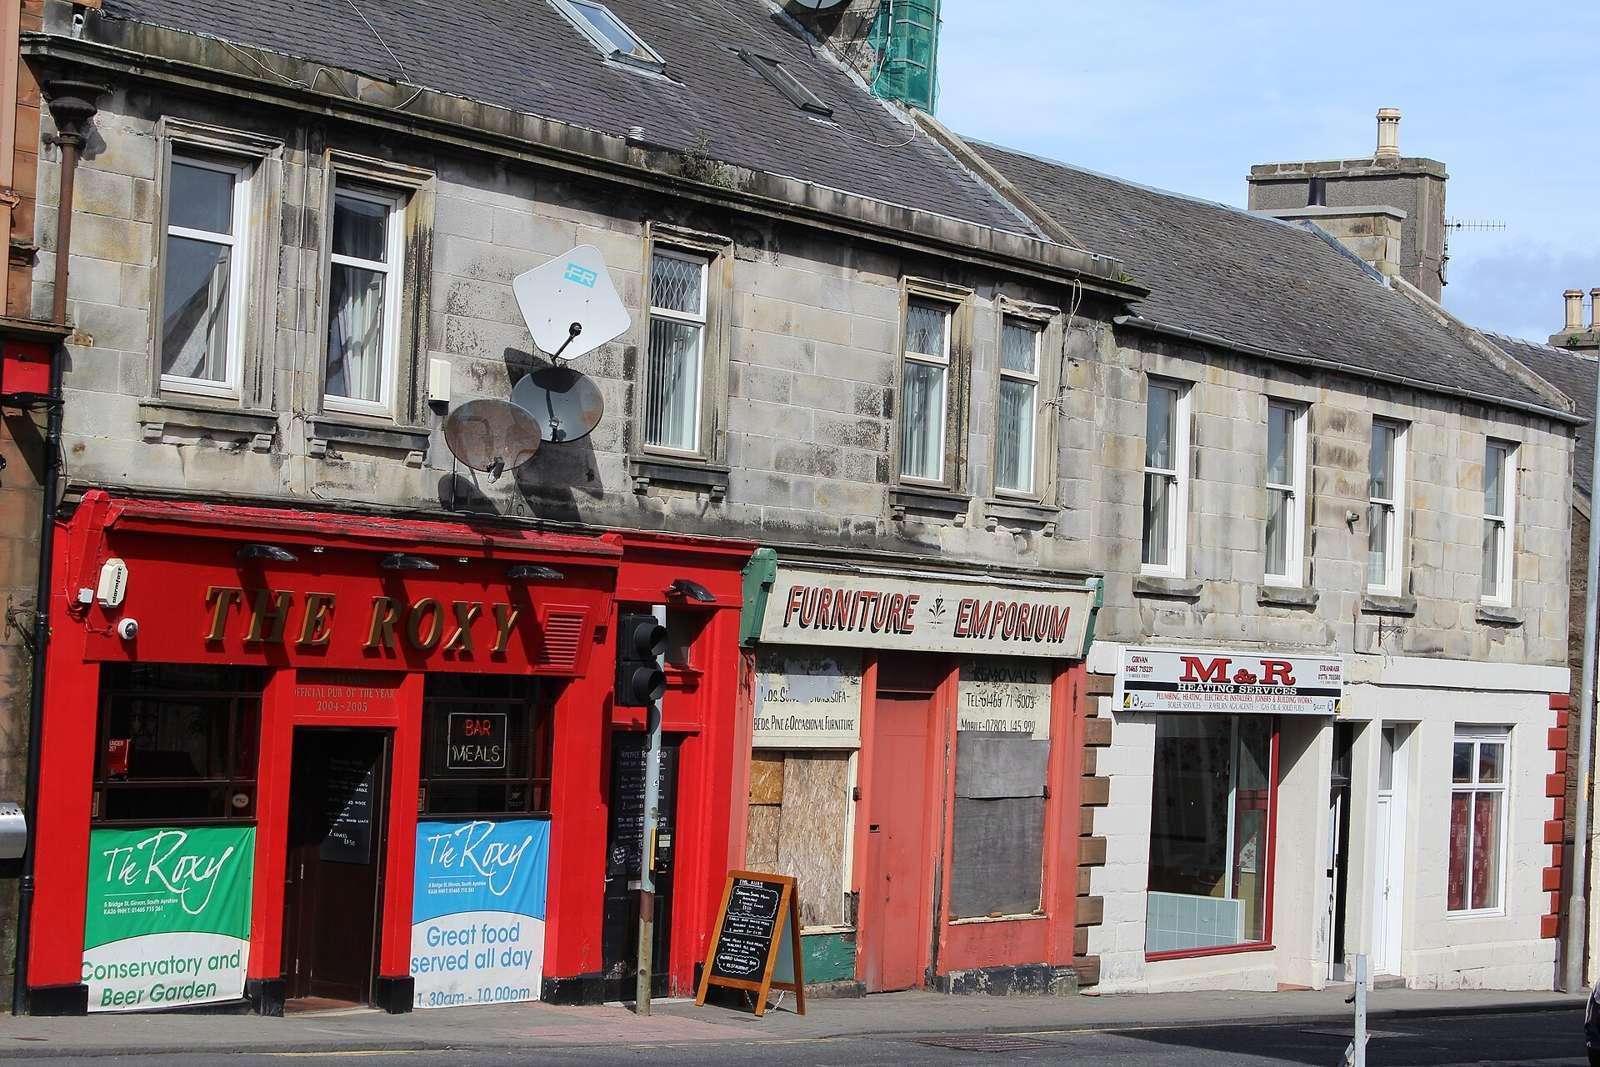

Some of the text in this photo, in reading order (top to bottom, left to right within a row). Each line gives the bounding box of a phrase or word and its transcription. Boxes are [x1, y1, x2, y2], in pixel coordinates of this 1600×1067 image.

[203, 586, 520, 655] THE ROXY
[784, 584, 1071, 644] FURNITURE EMPORIUM
[327, 687, 343, 698] PUB
[346, 687, 356, 698] OF
[360, 688, 373, 699] THE
[1178, 683, 1297, 695] HEATING SERVICES
[465, 719, 491, 736] BAR
[771, 715, 784, 731] PINE
[785, 717, 790, 731] &
[789, 715, 824, 731] OCCASIONAL
[825, 715, 854, 731] FURNITURE
[451, 744, 500, 762] MEALS
[427, 820, 533, 896] The Roxy
[103, 830, 234, 915] The Roxy
[427, 922, 520, 947] Great food
[82, 949, 240, 981] Conservatory and
[411, 947, 533, 973] served all day
[101, 981, 216, 1006] Beer Garden
